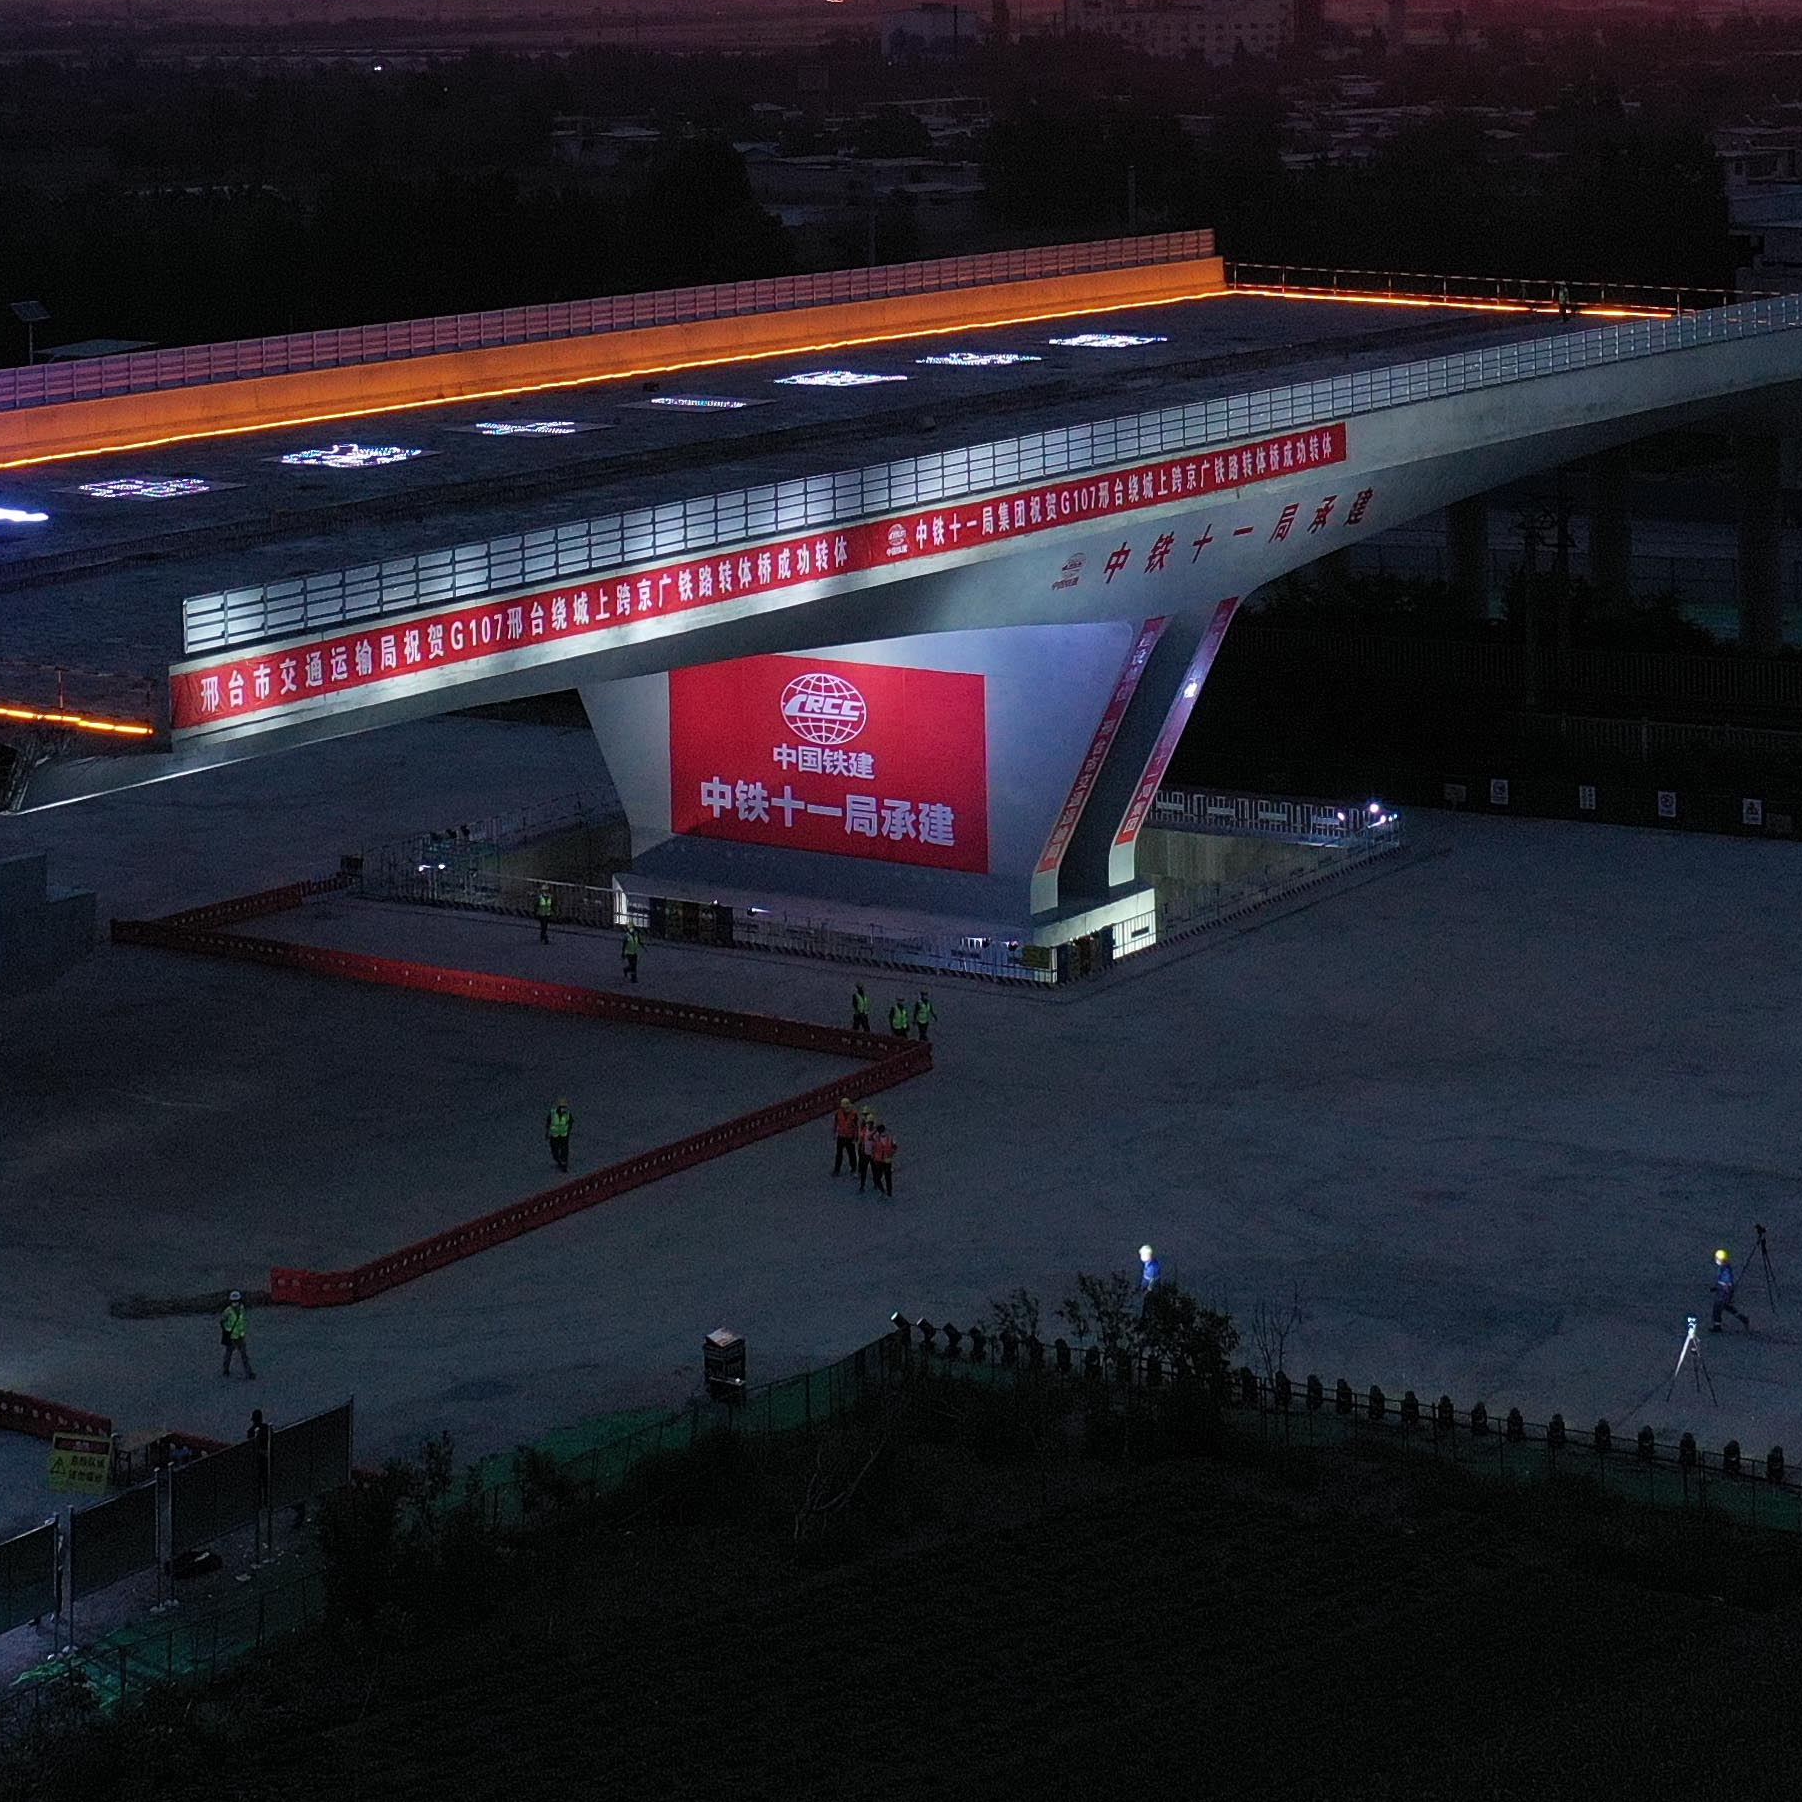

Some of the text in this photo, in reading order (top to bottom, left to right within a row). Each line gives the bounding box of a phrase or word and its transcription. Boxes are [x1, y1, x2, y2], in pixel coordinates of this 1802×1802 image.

[1104, 487, 1374, 584] 中铁十一局承建
[200, 535, 849, 715] 邢台市交通运输局祝贺G107邢台绕城上跨京广铁路转体桥成功转体
[773, 743, 876, 780] 中国铁建
[700, 777, 956, 847] 中铁十一局承建
